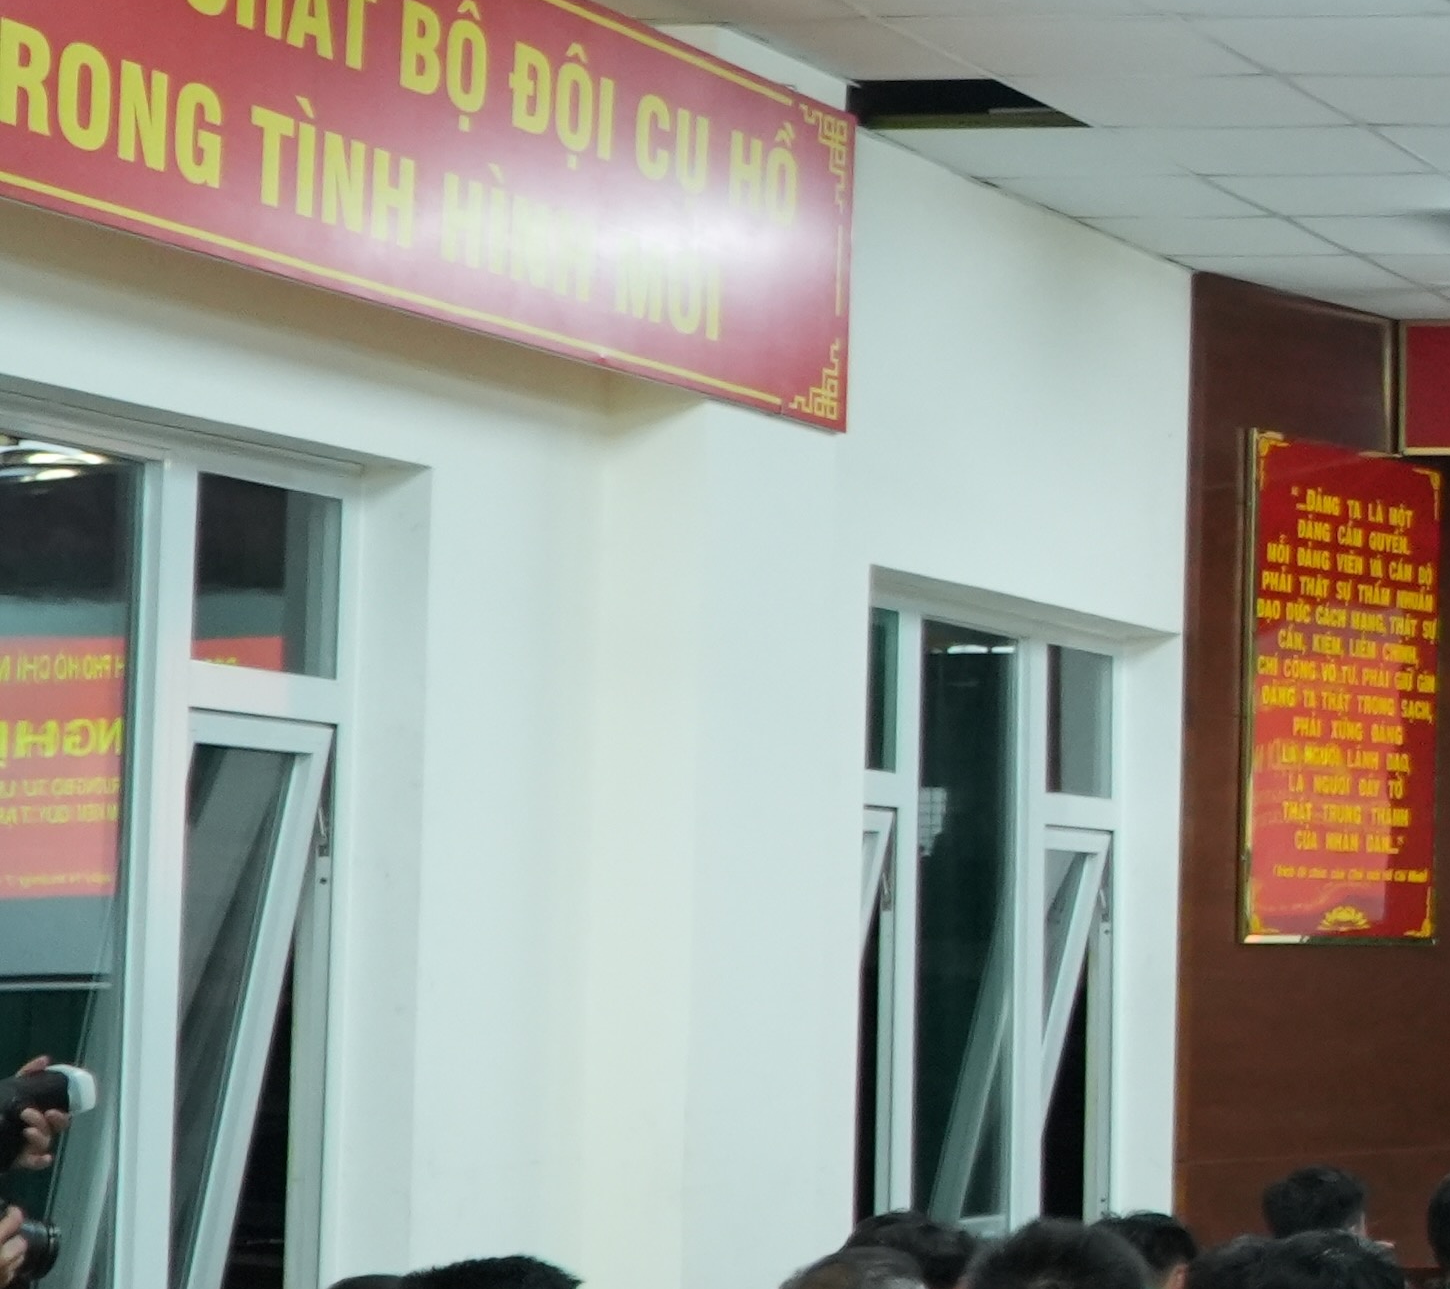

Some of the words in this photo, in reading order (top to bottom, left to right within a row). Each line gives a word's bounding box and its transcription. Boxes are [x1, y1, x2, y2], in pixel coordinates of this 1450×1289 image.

[251, 96, 415, 249] TÌNH
[440, 163, 592, 303] HÌNH
[508, 41, 616, 170] ĐỘI
[635, 94, 710, 219] CỤ
[729, 122, 799, 230] HỒ
[1347, 500, 1361, 519] TA
